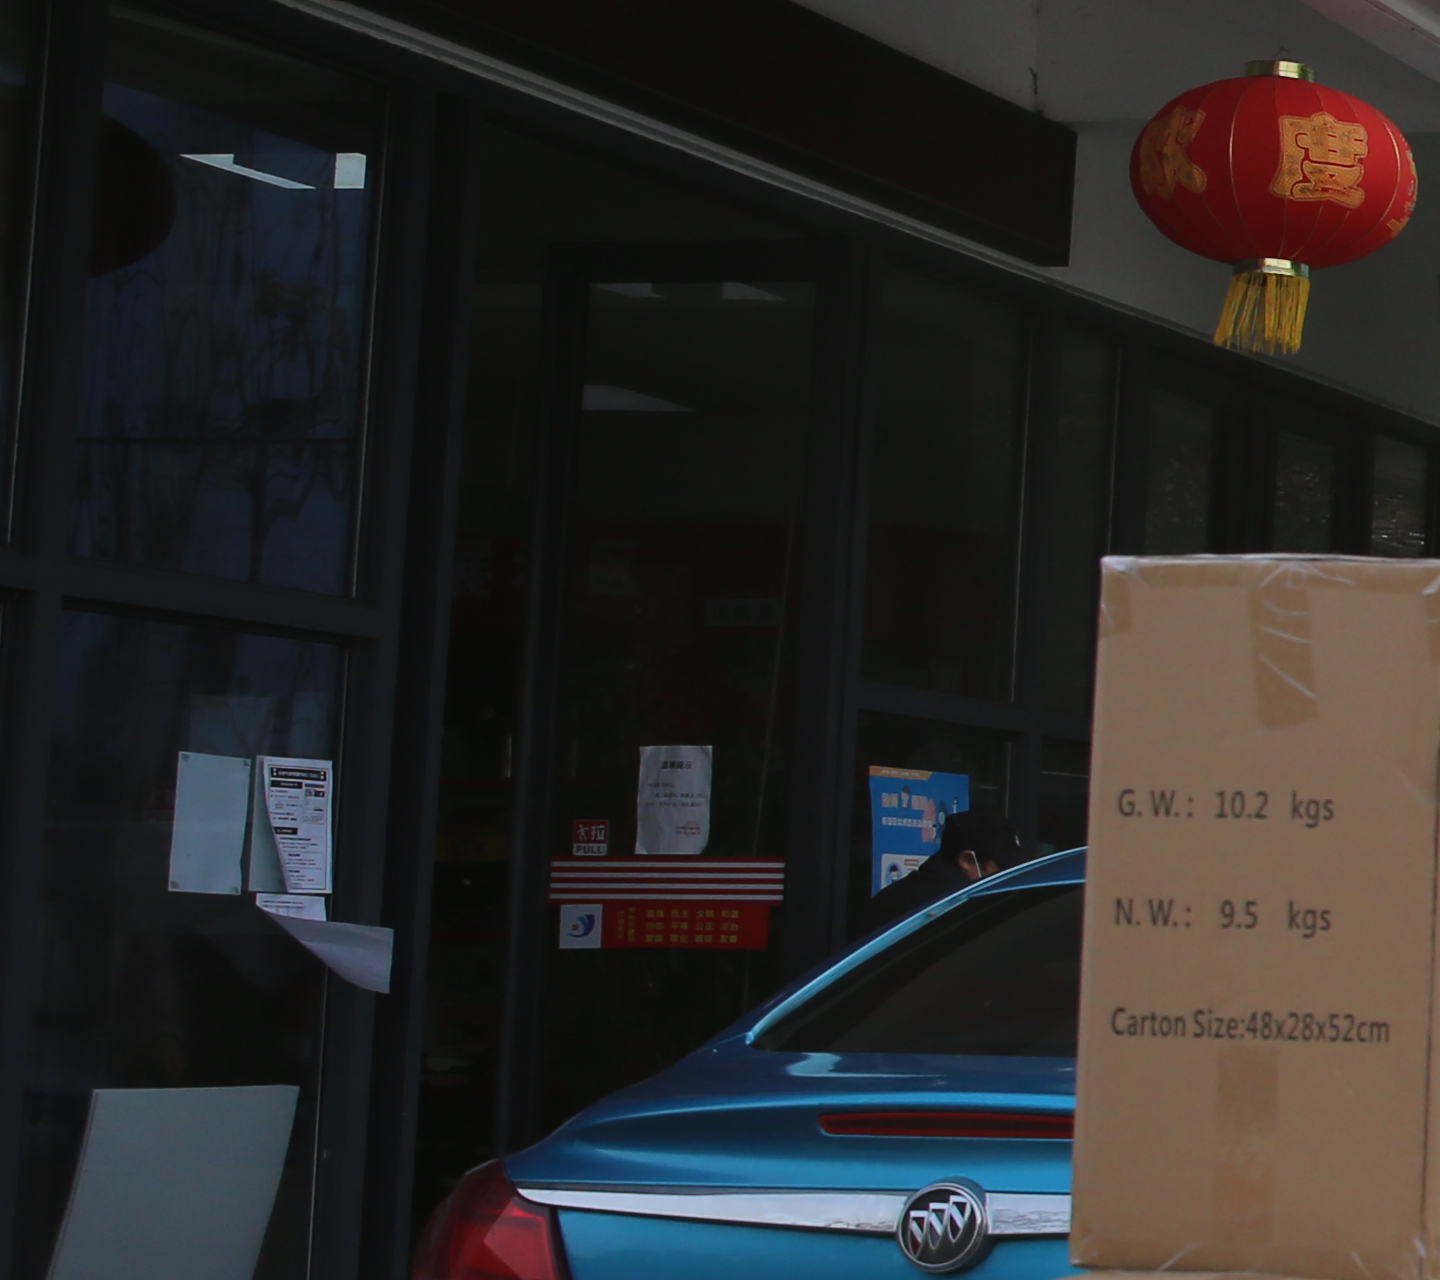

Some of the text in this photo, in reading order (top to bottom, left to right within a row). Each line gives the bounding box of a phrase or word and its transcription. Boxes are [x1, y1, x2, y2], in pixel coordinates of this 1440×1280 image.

[1215, 790, 1269, 820] 10.2
[1291, 790, 1335, 827] kgs
[576, 845, 604, 854] PULL
[591, 825, 605, 840] 拉
[1220, 901, 1259, 931] 9.5
[1287, 901, 1332, 939] kgs
[1111, 1007, 1391, 1044] Carton Size:48x28x52cm
